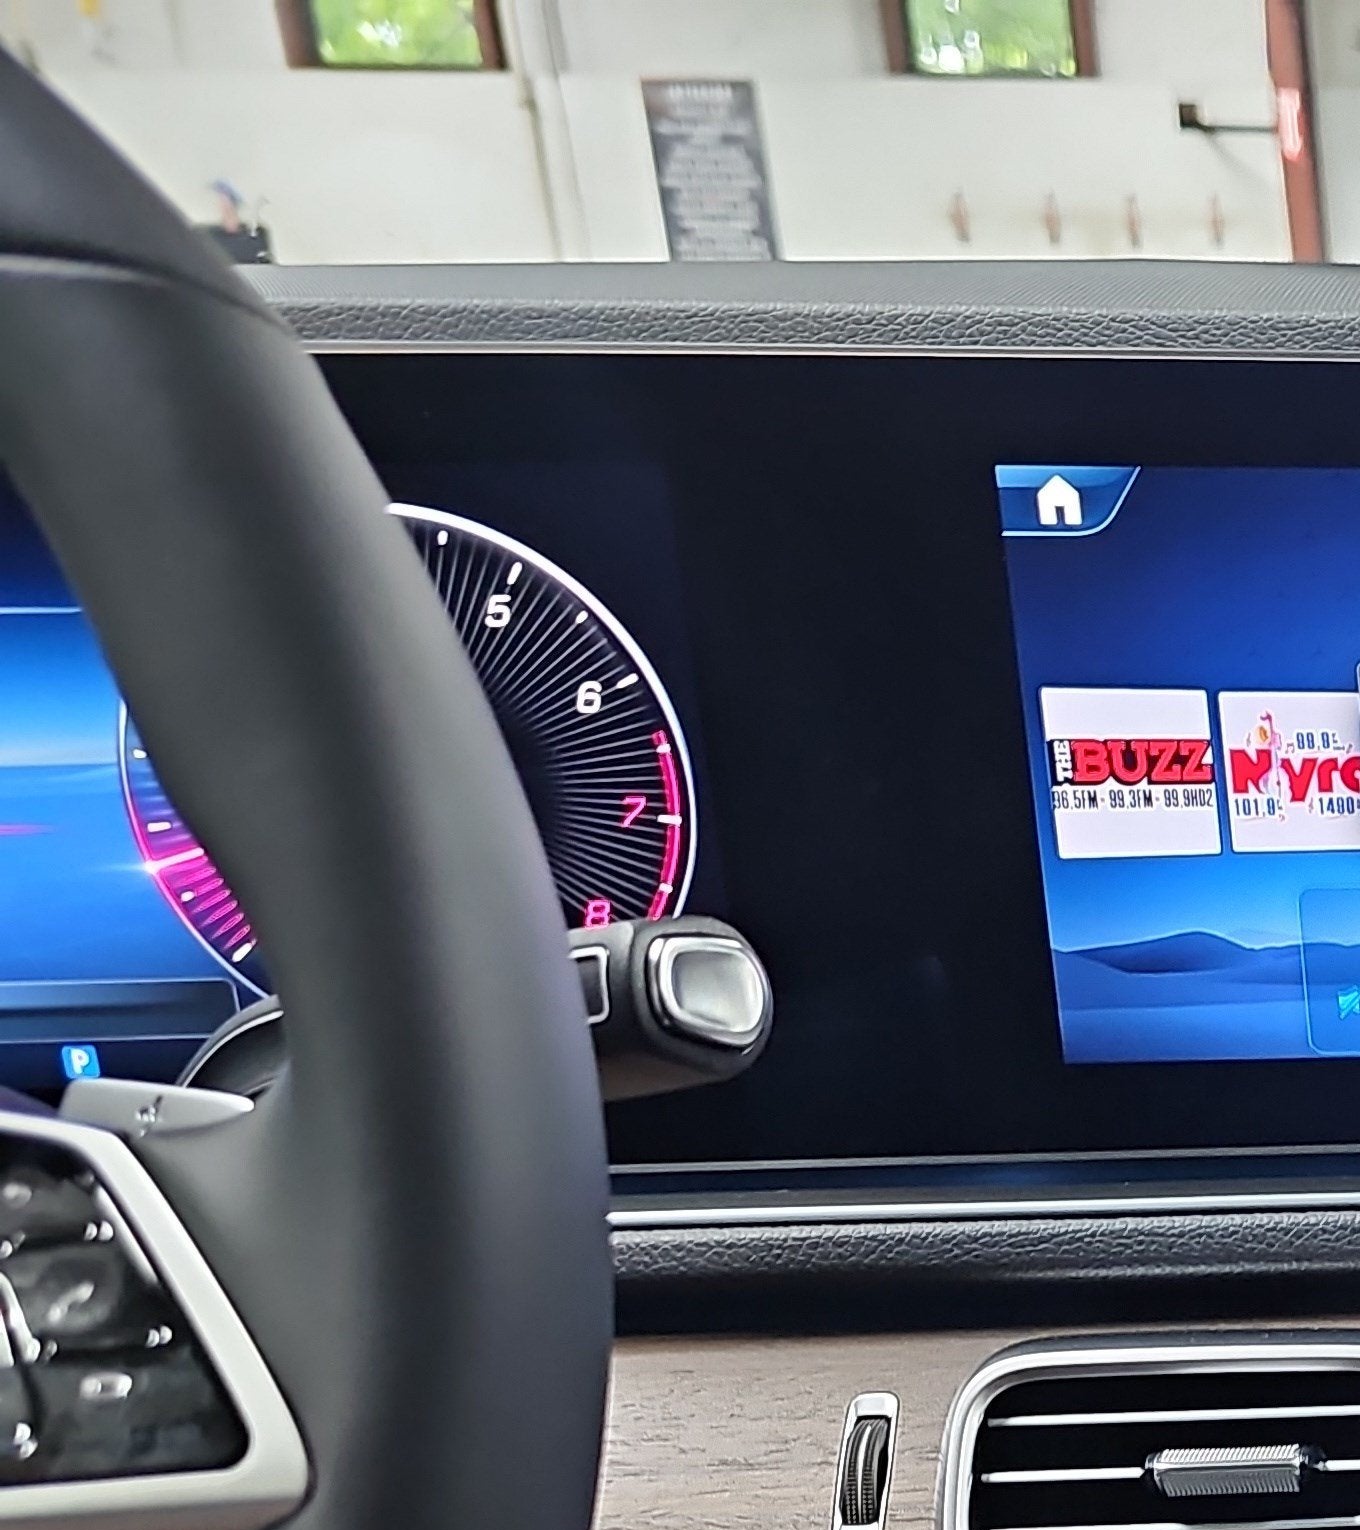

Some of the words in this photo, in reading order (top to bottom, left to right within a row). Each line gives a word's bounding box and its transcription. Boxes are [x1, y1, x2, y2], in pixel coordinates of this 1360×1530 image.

[484, 593, 512, 628] 5
[576, 680, 602, 714] 6
[1070, 739, 1214, 784] BUZZ
[621, 795, 647, 828] 7
[585, 899, 611, 930] 8
[70, 1048, 90, 1074] P
